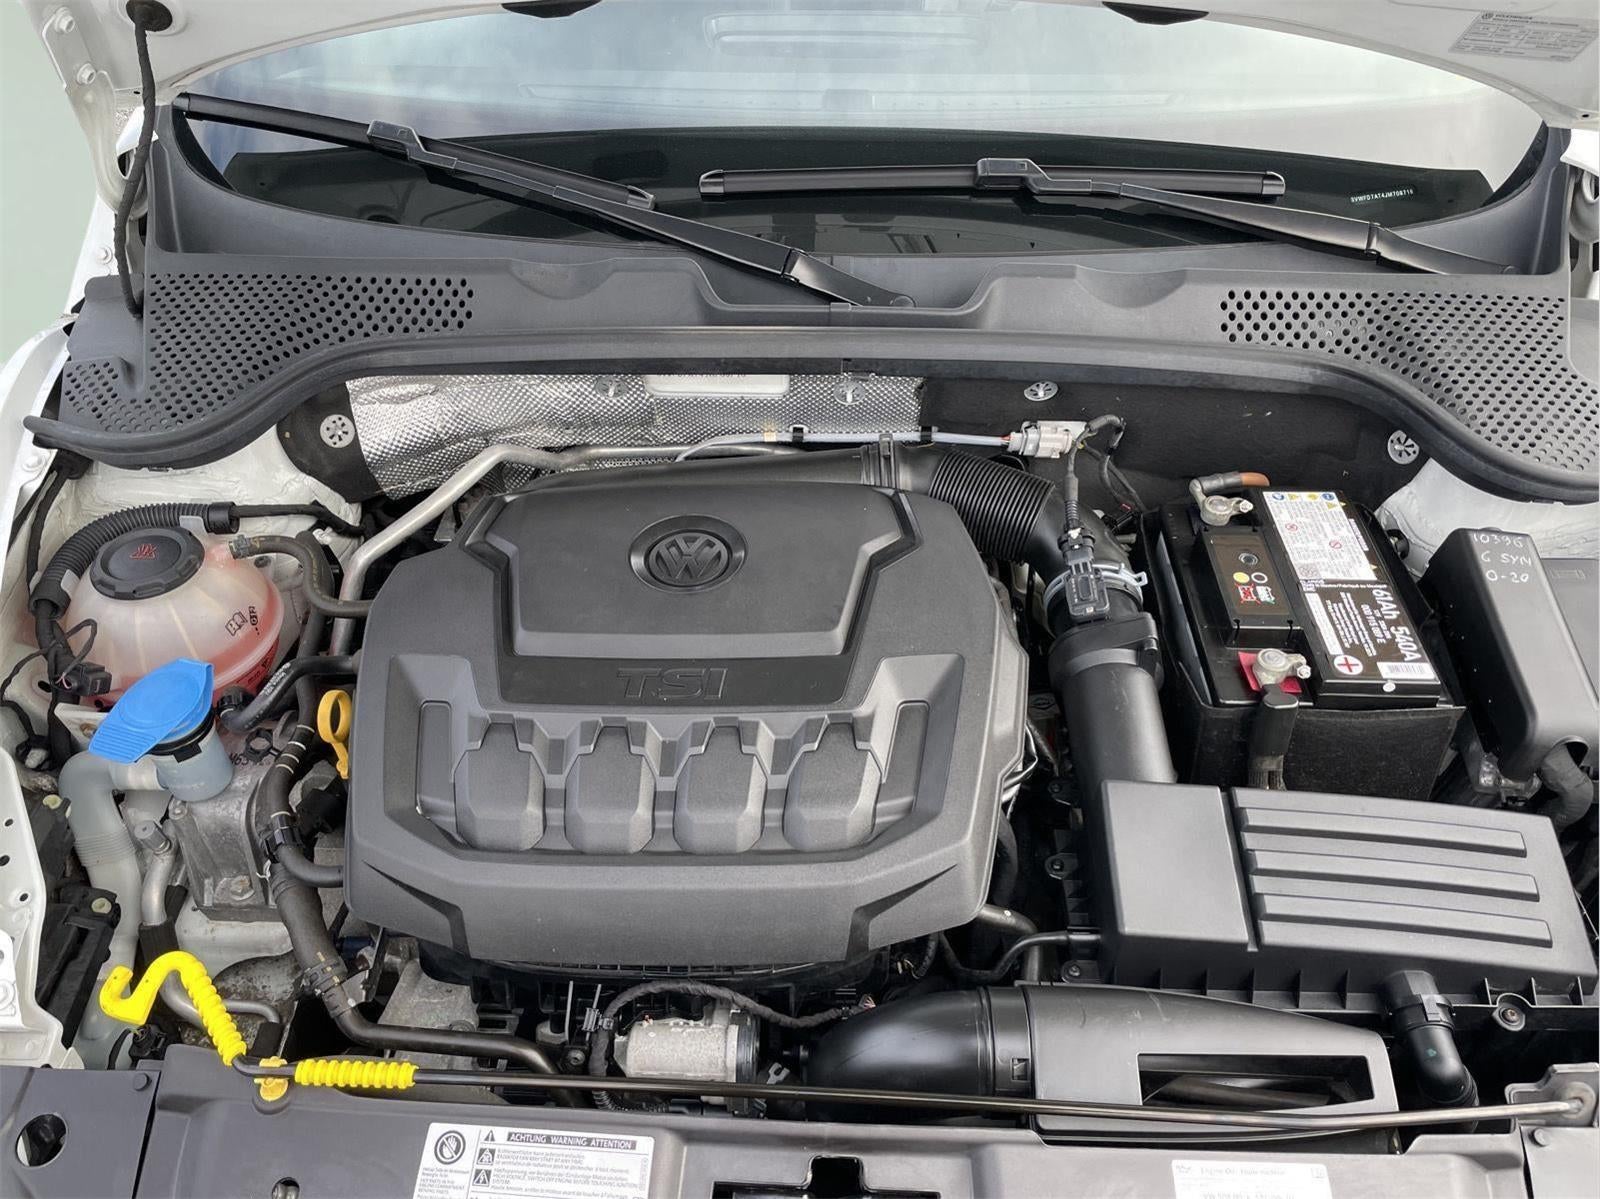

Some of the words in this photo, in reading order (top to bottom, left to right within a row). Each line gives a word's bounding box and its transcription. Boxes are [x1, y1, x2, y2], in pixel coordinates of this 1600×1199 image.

[1372, 588, 1401, 620] 61Ah
[1390, 625, 1422, 662] 540A
[616, 667, 728, 699] TSI
[510, 1132, 547, 1144] ACHTUNG
[550, 1135, 588, 1146] WARNING
[590, 1138, 632, 1150] ATTENTION
